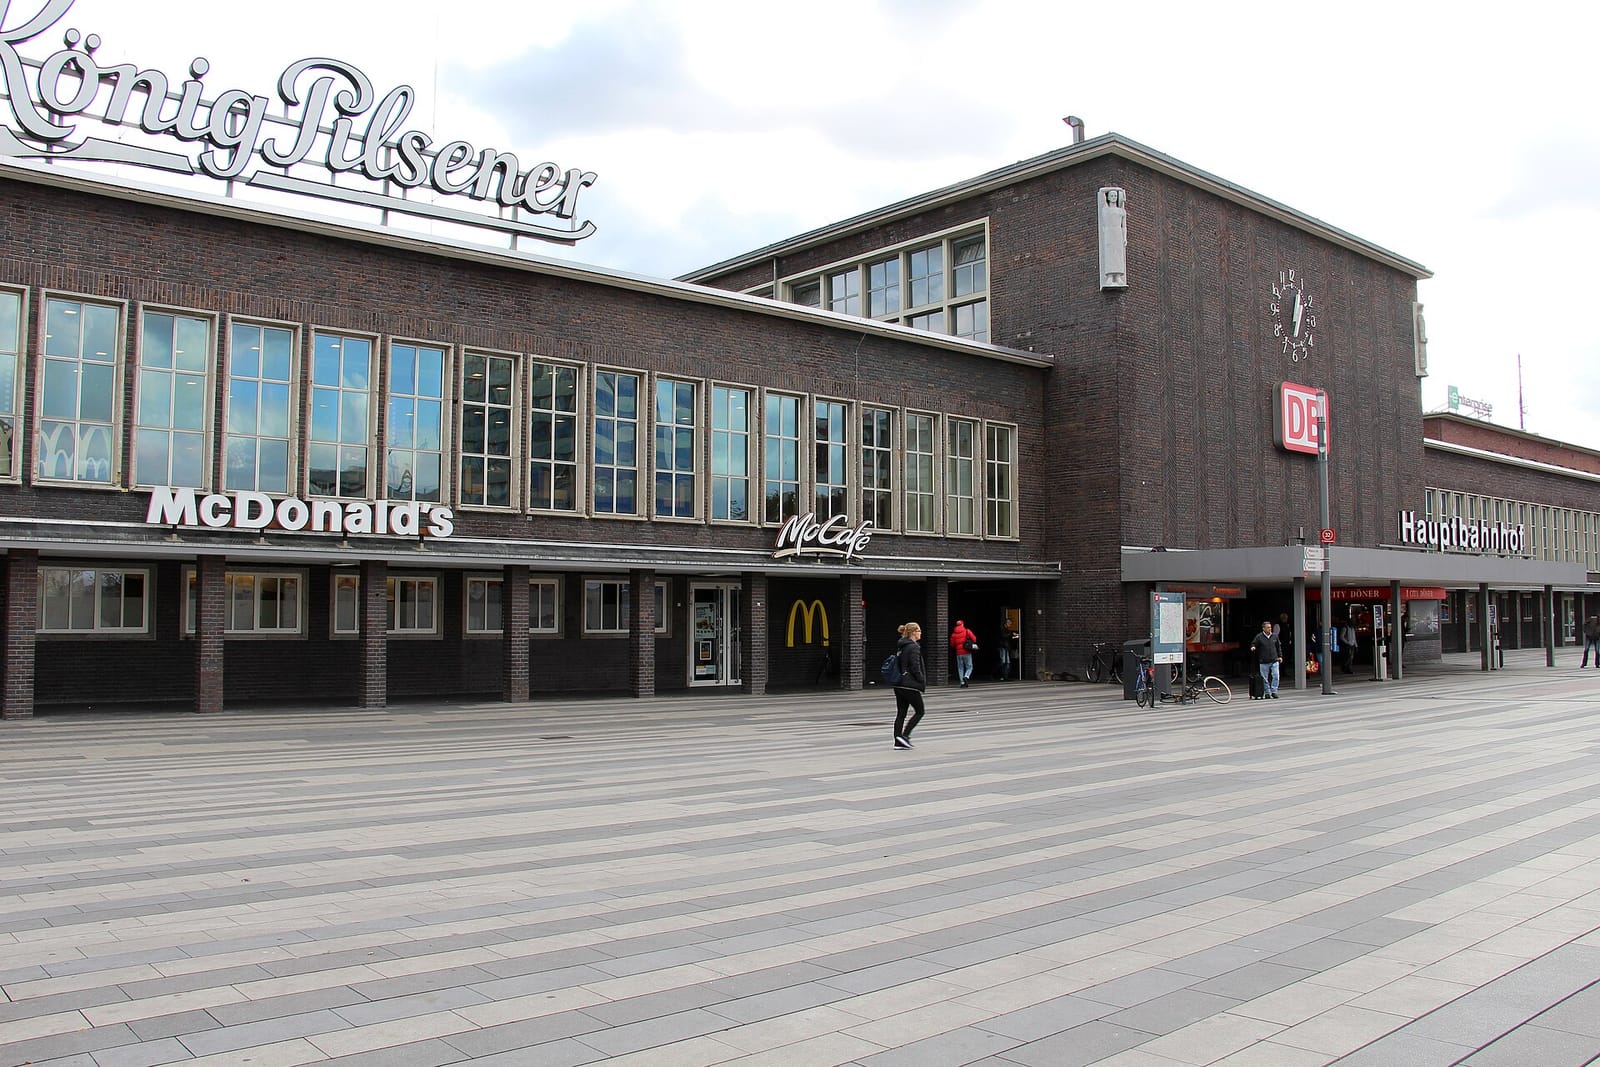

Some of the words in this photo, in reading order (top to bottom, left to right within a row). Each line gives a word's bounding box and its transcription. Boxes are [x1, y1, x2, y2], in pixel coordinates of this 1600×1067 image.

[261, 58, 598, 218] Pilsener
[1287, 394, 1320, 442] DB
[145, 486, 454, 537] McDonald's
[1400, 510, 1525, 552] Hauptbahnhof
[776, 512, 873, 560] McCafé
[1329, 590, 1346, 599] ITY
[1350, 589, 1380, 598] DÖNER
